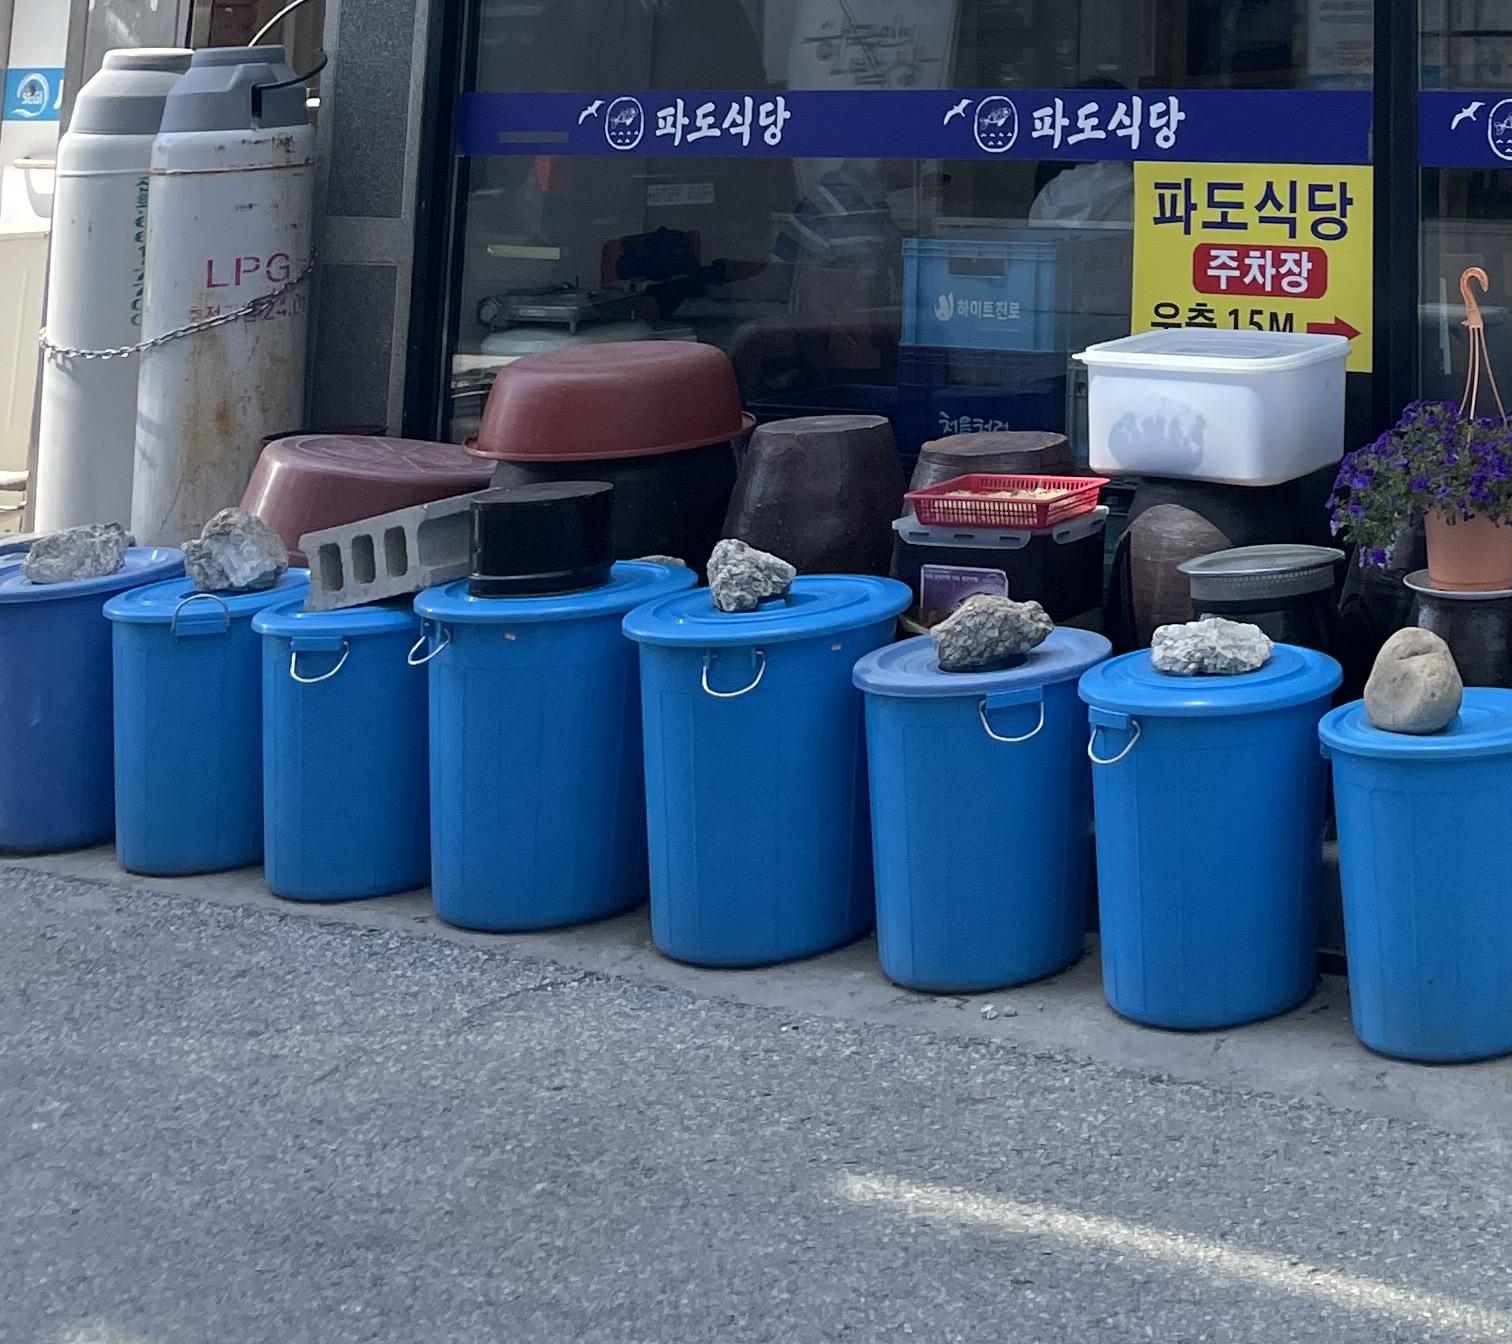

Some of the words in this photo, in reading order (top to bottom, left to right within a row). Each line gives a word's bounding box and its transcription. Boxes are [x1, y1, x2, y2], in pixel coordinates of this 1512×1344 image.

[655, 95, 792, 147] 파도식당
[1031, 95, 1186, 150] 파도식당
[1153, 177, 1354, 240] 파도식당
[206, 253, 290, 289] LPG
[1206, 248, 1312, 294] 주차장
[1228, 308, 1294, 334] 15M
